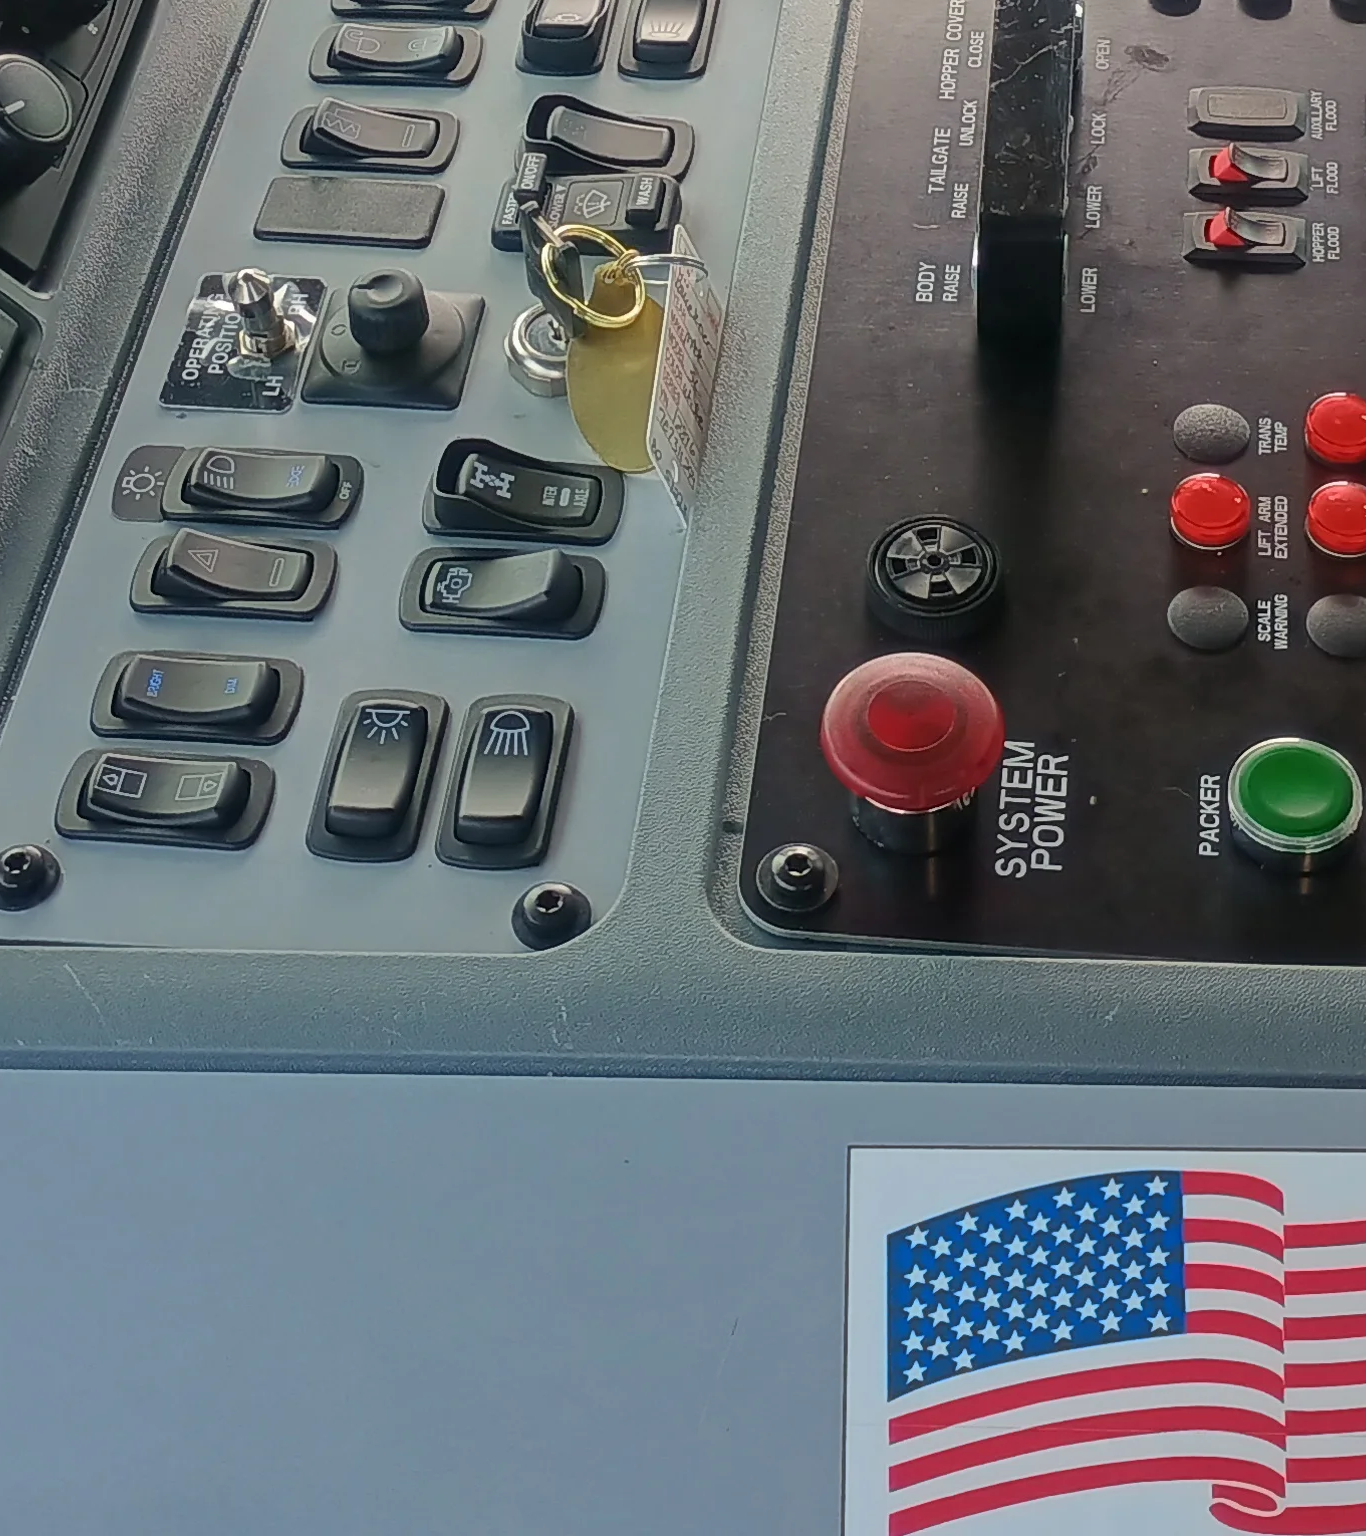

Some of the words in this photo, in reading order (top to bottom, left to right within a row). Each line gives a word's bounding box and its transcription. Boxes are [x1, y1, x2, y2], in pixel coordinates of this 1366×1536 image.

[945, 0, 967, 41] COVER
[967, 31, 986, 69] CLOSE
[1095, 38, 1112, 71] OPEN
[939, 47, 961, 100] HOPPER
[958, 100, 978, 147] UNLOCK
[1090, 112, 1108, 146] LOCK
[1325, 99, 1338, 132] FLOOD
[520, 154, 541, 190] ON/OFF
[928, 127, 952, 195] TAILGATE
[1311, 166, 1325, 190] LIFT
[1326, 161, 1340, 195] FLOOD
[635, 176, 654, 206] WASH
[950, 182, 970, 219] RAISE
[1085, 185, 1103, 229] LOWER
[1312, 221, 1326, 264] HOPPER
[1327, 225, 1341, 261] FLOOD
[915, 261, 937, 303] BODY
[942, 264, 962, 302] RAISE
[1079, 267, 1099, 314] LOWER
[181, 293, 225, 382] OPERATING
[207, 312, 241, 375] POSITIO
[261, 375, 284, 397] LH
[1258, 416, 1272, 456] TRANS
[1274, 421, 1289, 453] TEMP
[338, 480, 352, 500] OFF
[573, 487, 590, 507] AXLE
[1258, 496, 1272, 524] ARM
[1274, 495, 1289, 560] EXTENDED
[1258, 528, 1272, 557] LIFT
[1258, 600, 1272, 642] SCALE
[1274, 594, 1289, 650] WARNING
[994, 740, 1036, 879] SYSTEM
[1030, 754, 1070, 871] POWER
[1198, 774, 1222, 858] PACKER
